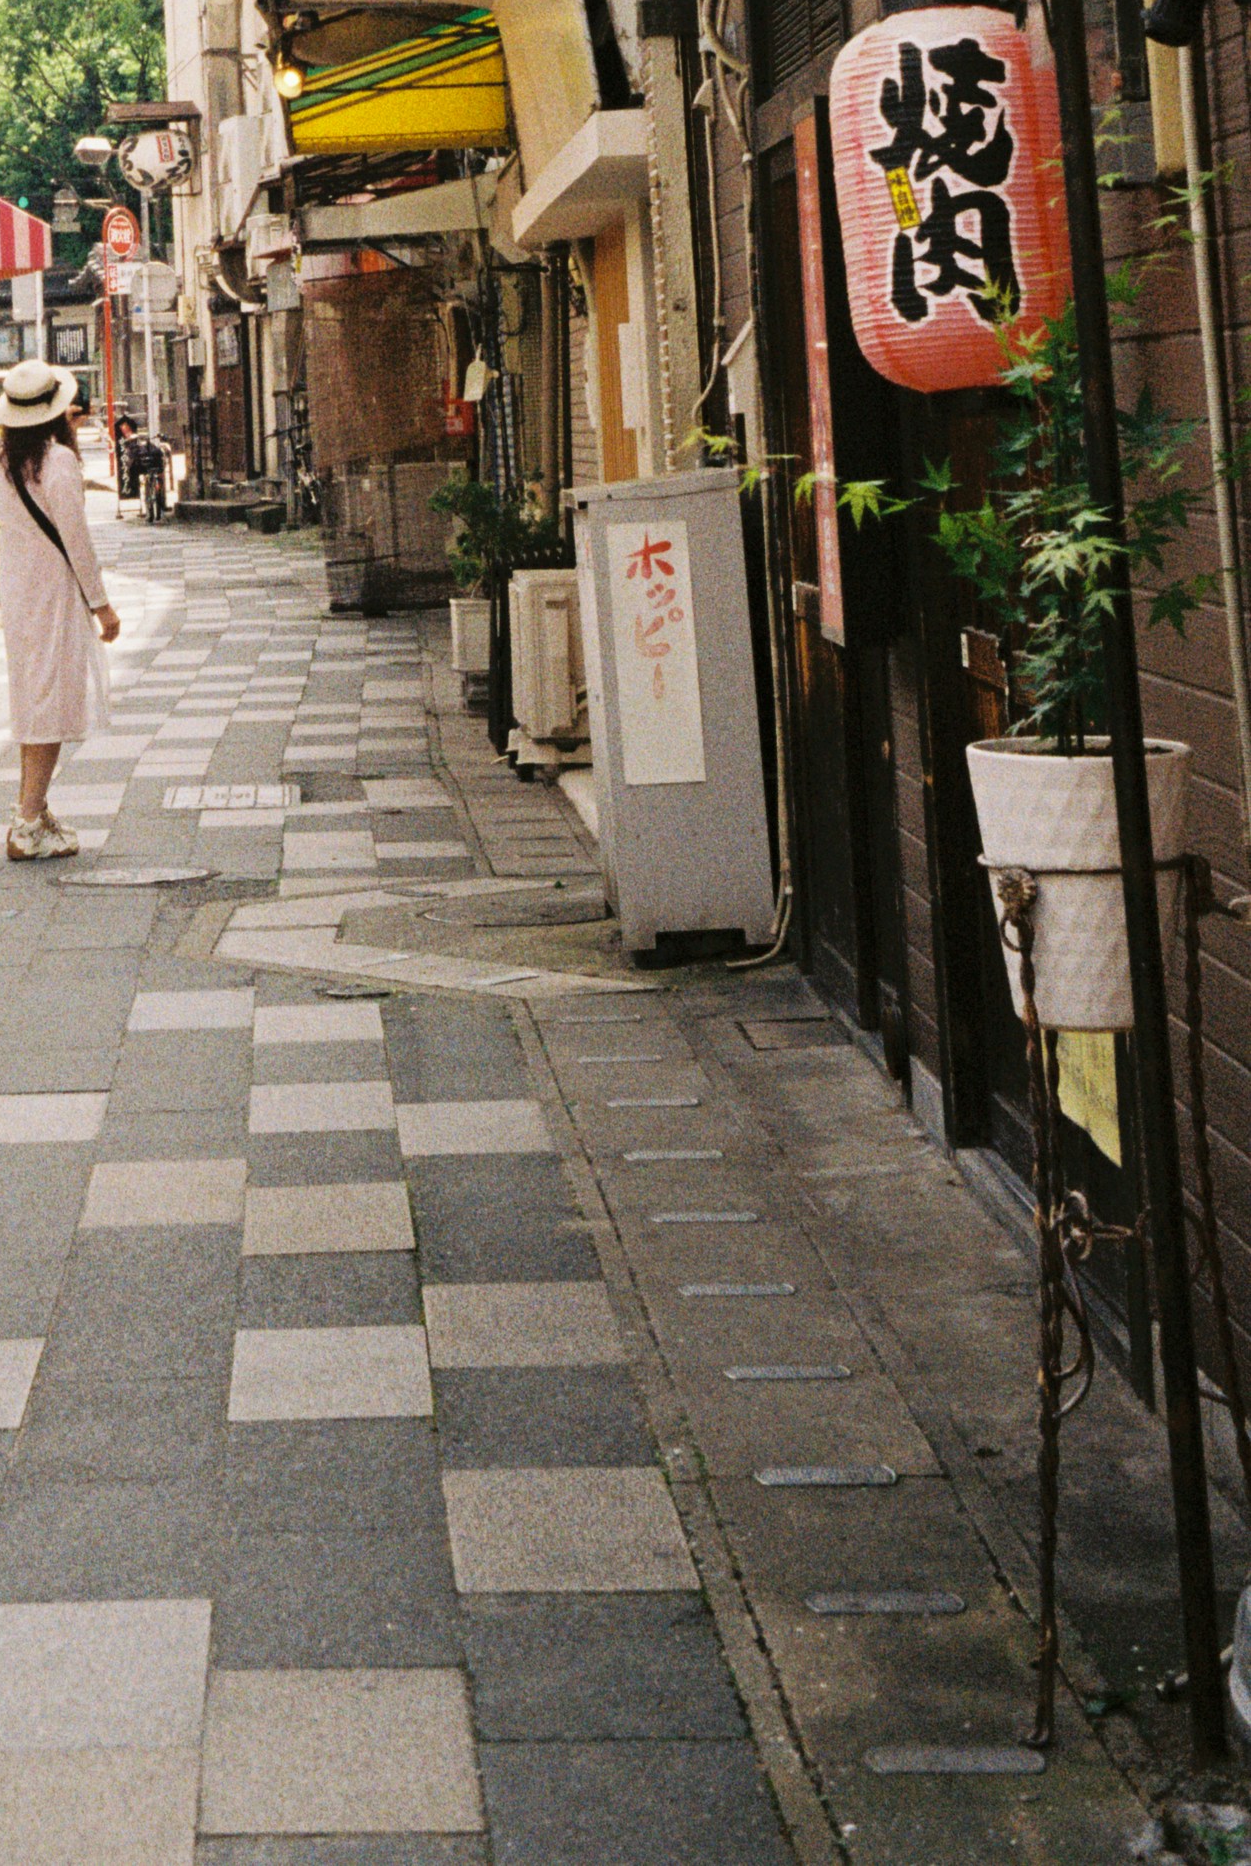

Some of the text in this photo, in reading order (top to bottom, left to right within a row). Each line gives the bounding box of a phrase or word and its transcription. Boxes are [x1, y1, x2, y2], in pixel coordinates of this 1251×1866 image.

[868, 38, 1021, 322] 焼肉
[625, 530, 684, 700] ホッピー
